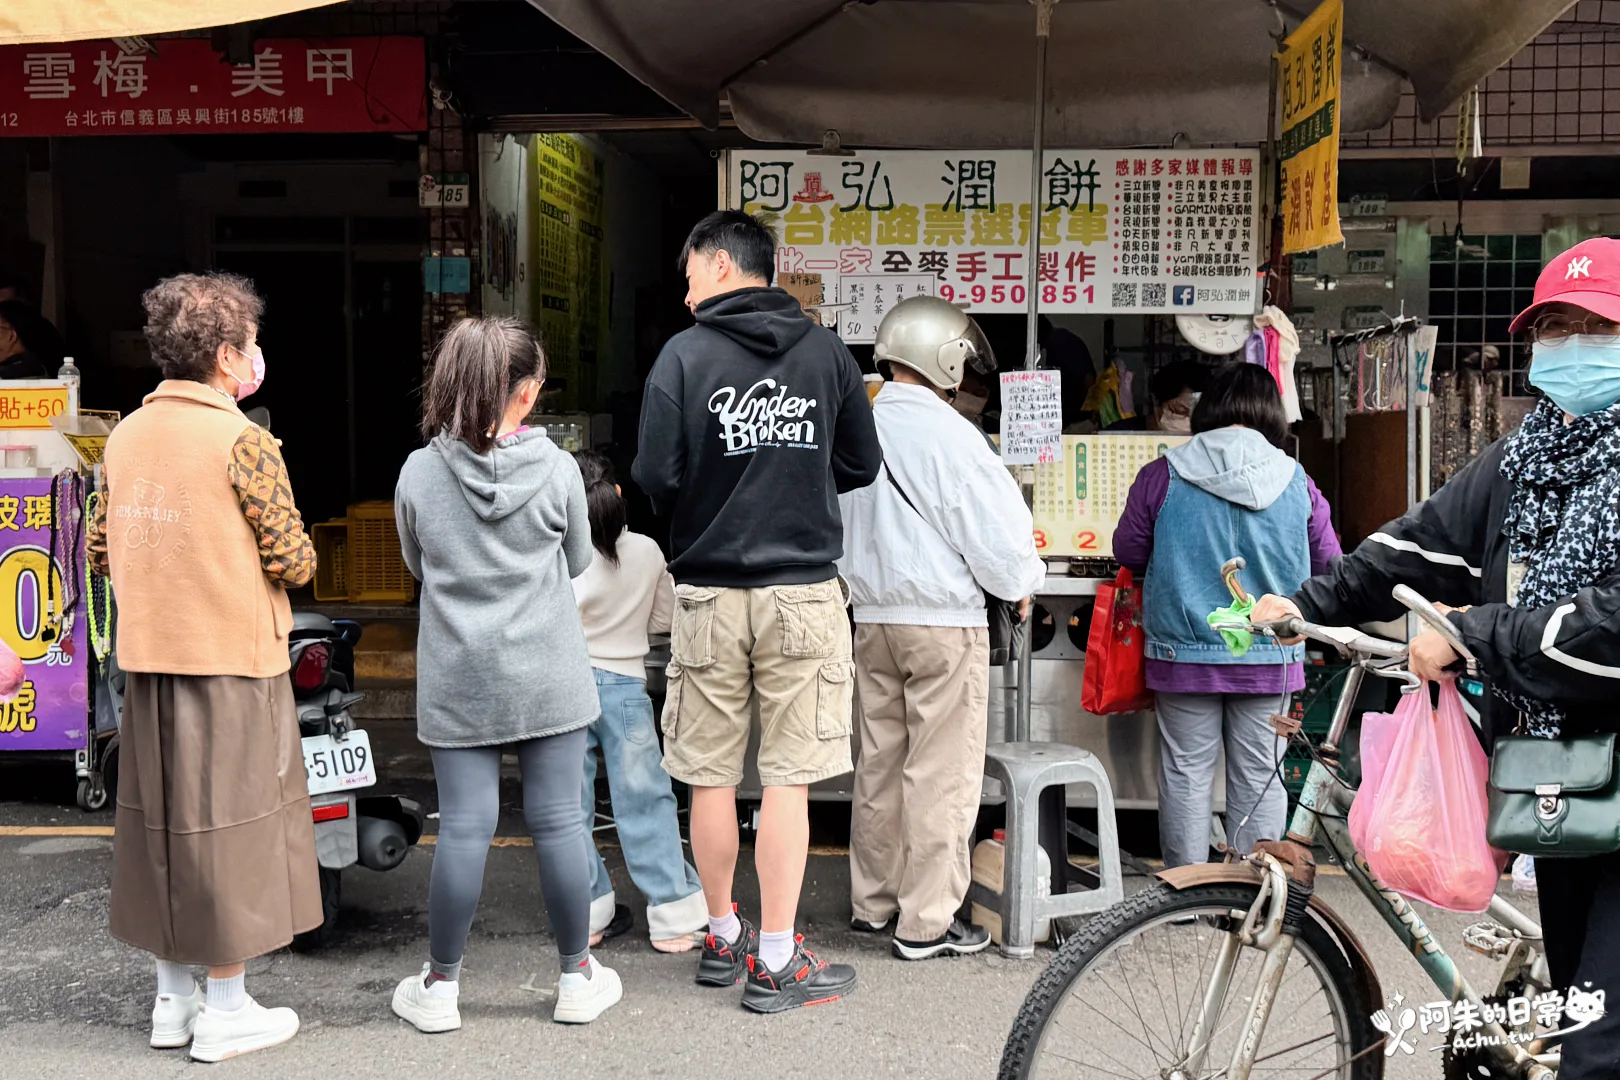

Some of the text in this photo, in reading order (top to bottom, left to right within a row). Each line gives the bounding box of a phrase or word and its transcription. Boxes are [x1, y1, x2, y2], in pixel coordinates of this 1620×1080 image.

[65, 106, 305, 128] 台北市信義區吳興街185號1樓
[1115, 158, 1253, 176] 感謝多家媒體報導
[436, 187, 464, 202] 185
[1123, 204, 1160, 215] 台視新聞
[744, 202, 1109, 247] 台網路票選冠軍
[1123, 217, 1160, 228] 民視新聞
[1123, 229, 1160, 240] 中天新聞
[1122, 241, 1159, 252] 蘋果日報
[1122, 253, 1159, 264] 自由時報
[874, 283, 884, 315] 冬瓜茶
[1197, 288, 1251, 302] 阿弘潤餅
[847, 321, 862, 336] 50
[708, 378, 817, 425] Under
[1077, 530, 1098, 549] 2
